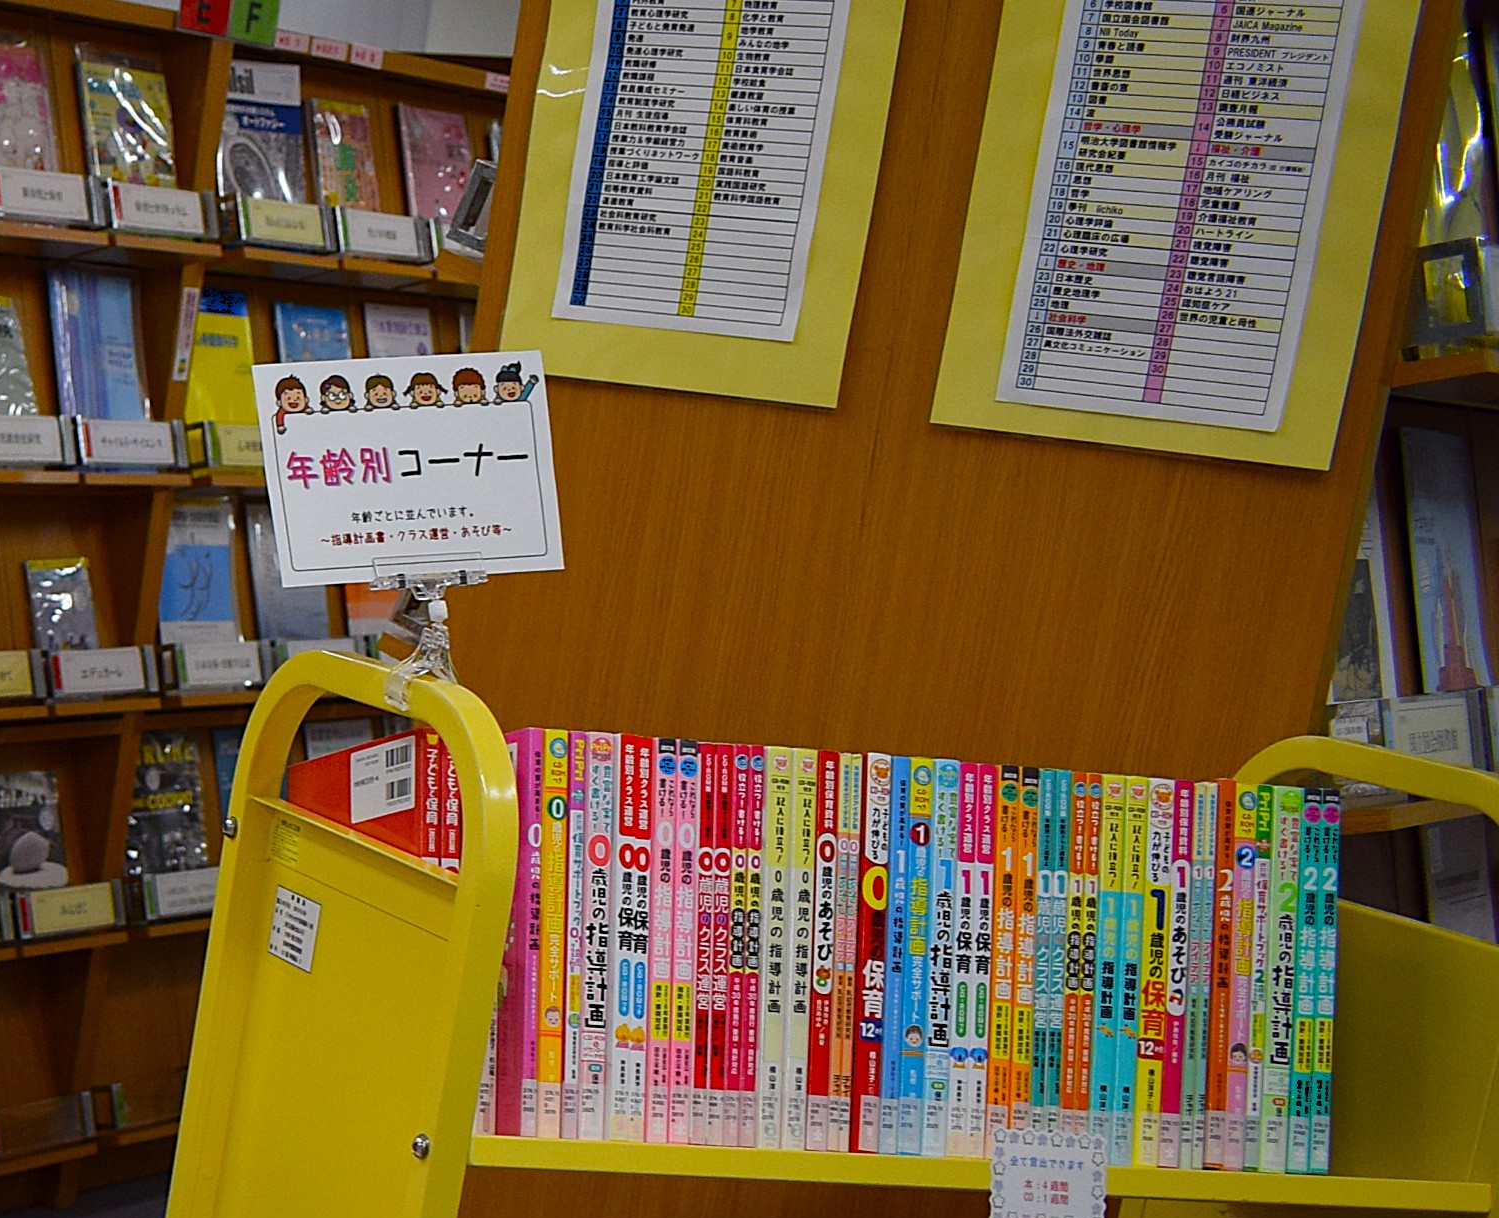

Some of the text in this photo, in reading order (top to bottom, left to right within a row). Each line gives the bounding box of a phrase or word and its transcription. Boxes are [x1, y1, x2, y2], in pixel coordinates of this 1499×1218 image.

[245, 1, 262, 33] F
[1262, 22, 1303, 34] Magazine
[1226, 61, 1284, 73] エコノミスト
[1195, 227, 1254, 238] ハートライン
[286, 443, 529, 489] 年齢別コーナー
[351, 506, 474, 524] 年齢ごとに並んでいます。
[639, 747, 650, 830] 年齢別クラス運営
[767, 870, 783, 1014] 0歳児の指導計画
[793, 870, 810, 1014] 0歳児の指導計画
